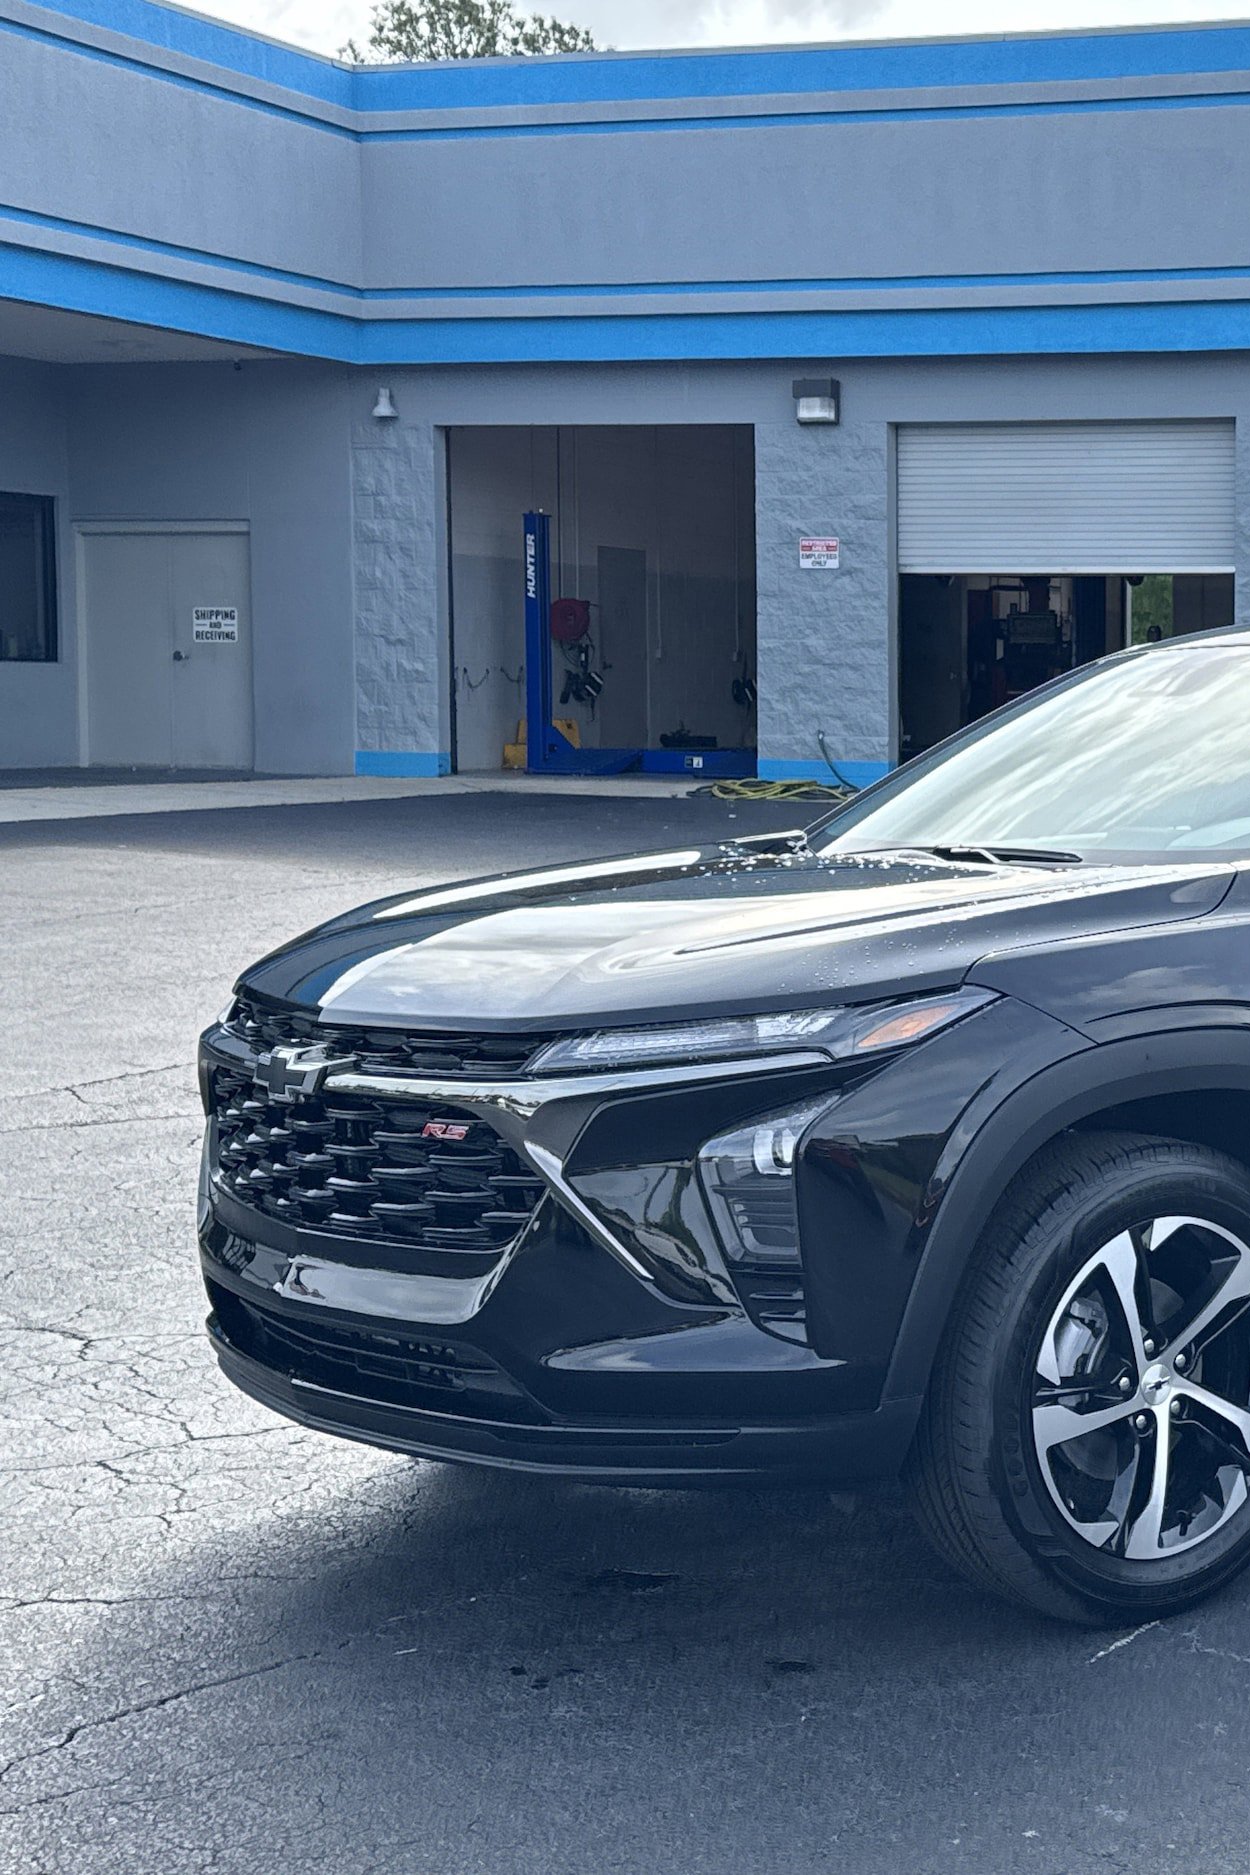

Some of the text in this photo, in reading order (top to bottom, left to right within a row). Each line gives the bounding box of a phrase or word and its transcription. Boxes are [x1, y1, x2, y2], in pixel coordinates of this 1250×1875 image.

[526, 533, 536, 598] HUNTER
[194, 609, 235, 620] SHIPPING
[195, 630, 236, 641] RECEIVING
[421, 1122, 470, 1140] RS
